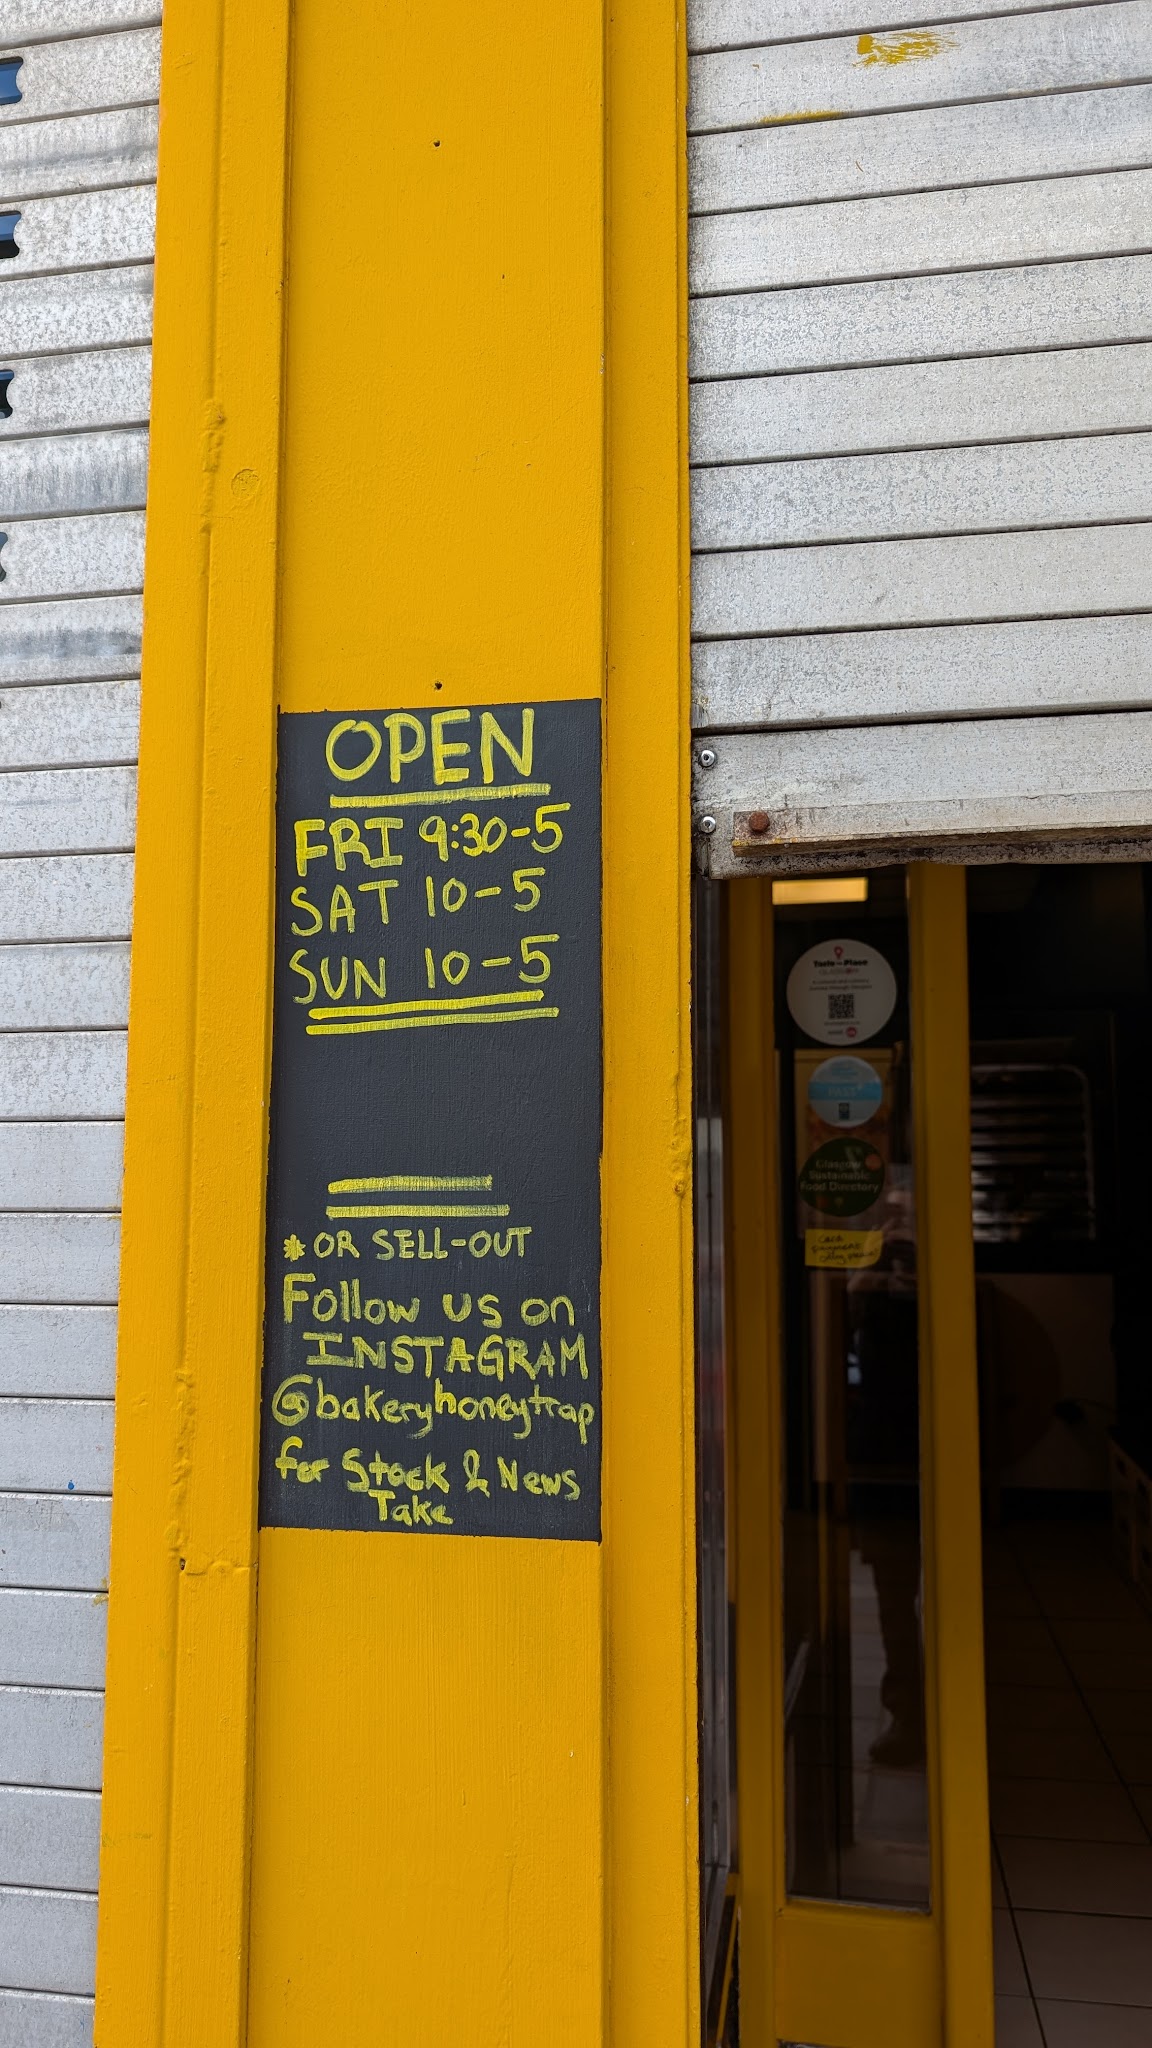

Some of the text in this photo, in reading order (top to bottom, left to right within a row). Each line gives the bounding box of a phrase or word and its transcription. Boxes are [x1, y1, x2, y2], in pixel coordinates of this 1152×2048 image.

[325, 708, 534, 785] OPEN
[294, 803, 571, 877] FRI 9:30-5
[291, 880, 398, 936] SAT
[289, 949, 390, 1004] SUN
[800, 1181, 879, 1194] Food Directory
[815, 1159, 861, 1171] Glasgow
[373, 1228, 532, 1260] SELL-OUT
[283, 1273, 574, 1328] Follow us on
[302, 1332, 588, 1381] INSTAGRAM
[272, 1374, 594, 1444] @bakeryhoneytrap
[275, 1436, 581, 1500] for Stock & News
[368, 1488, 453, 1526] Take
